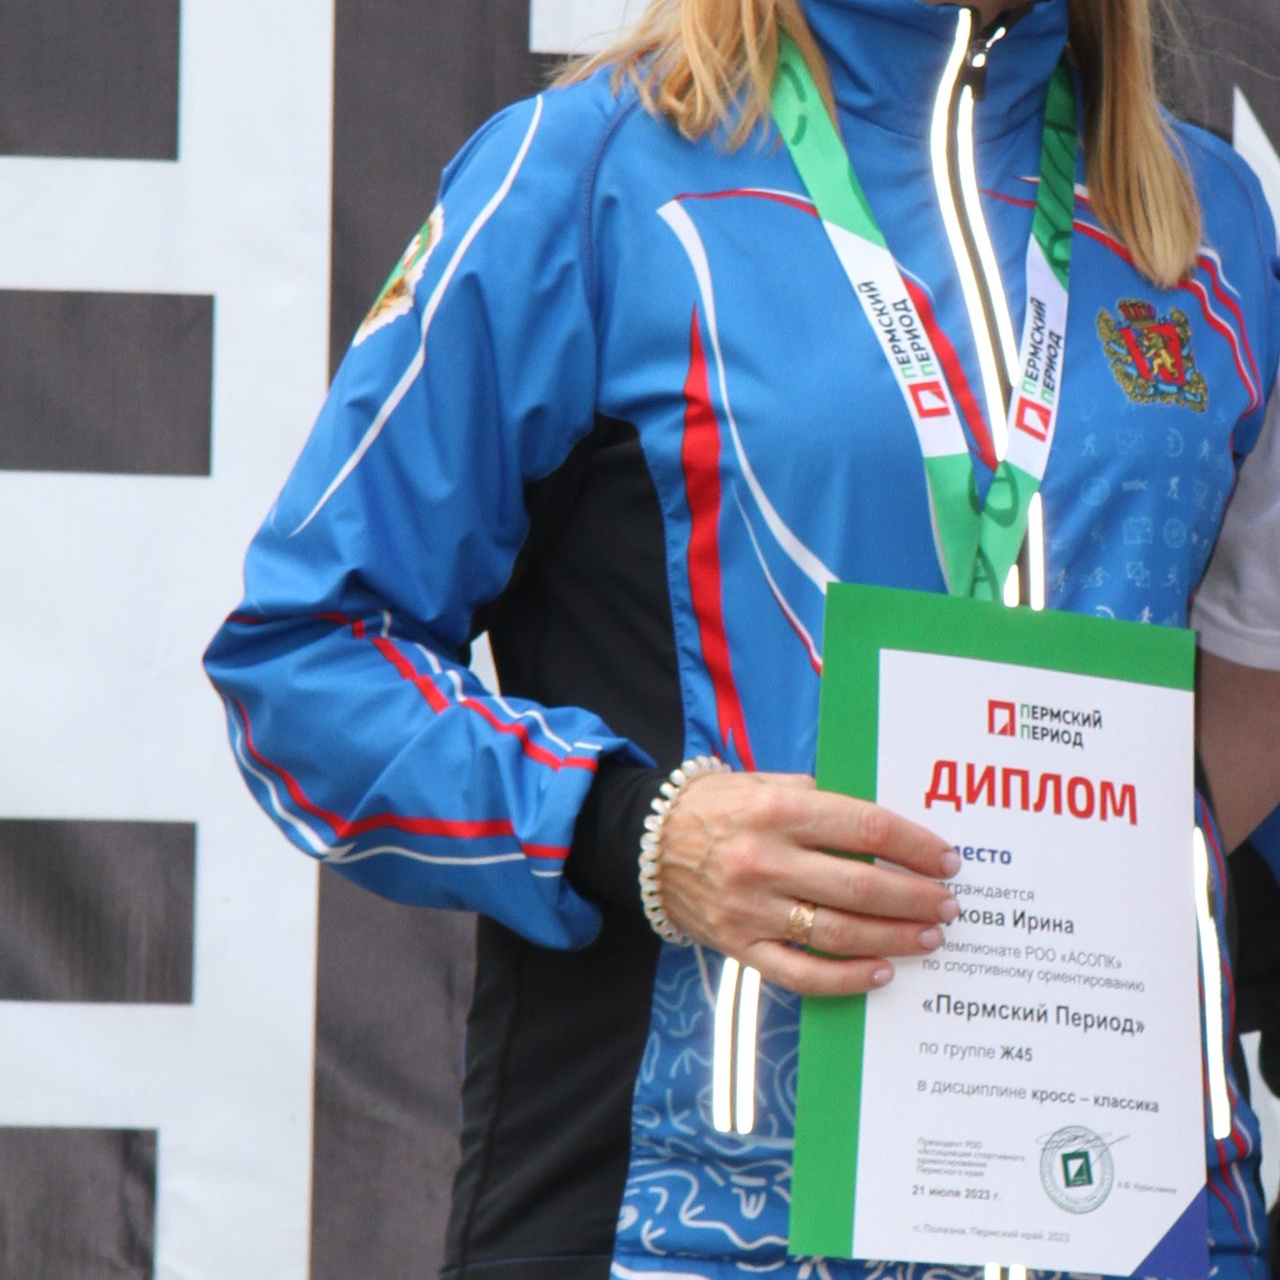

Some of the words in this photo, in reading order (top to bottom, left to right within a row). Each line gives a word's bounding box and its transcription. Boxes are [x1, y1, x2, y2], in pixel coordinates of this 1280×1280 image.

[858, 281, 917, 379] ПЕРМСКИЙ
[893, 298, 936, 376] ПЕРИОД
[1021, 296, 1046, 396] ПЕРМСКИЙ
[1040, 331, 1062, 405] ПЕРИОД
[1020, 703, 1103, 730] ПЕРМСКИЙ
[1020, 723, 1084, 749] ПЕРИОД
[924, 759, 1137, 826] ДИПЛОМ
[934, 881, 1035, 901] граждается
[1013, 909, 1074, 934] Ирина
[1025, 946, 1057, 962] РОО
[1061, 952, 1122, 969] «АСОПК»
[922, 958, 940, 970] по
[944, 960, 1034, 982] спортивному
[1038, 969, 1145, 993] ориентированию
[922, 994, 1049, 1024] «Пермский
[1056, 1006, 1145, 1036] Период»
[919, 1041, 939, 1056] по
[944, 1043, 995, 1061] группе
[1000, 1044, 1033, 1062] Ж45
[917, 1080, 928, 1092] в
[931, 1080, 1027, 1102] дисциплине
[1031, 1088, 1076, 1106] кросс
[1093, 1093, 1160, 1113] классика
[912, 1184, 924, 1195] 21
[929, 1188, 961, 1197] июля
[965, 1188, 990, 1200] 2023
